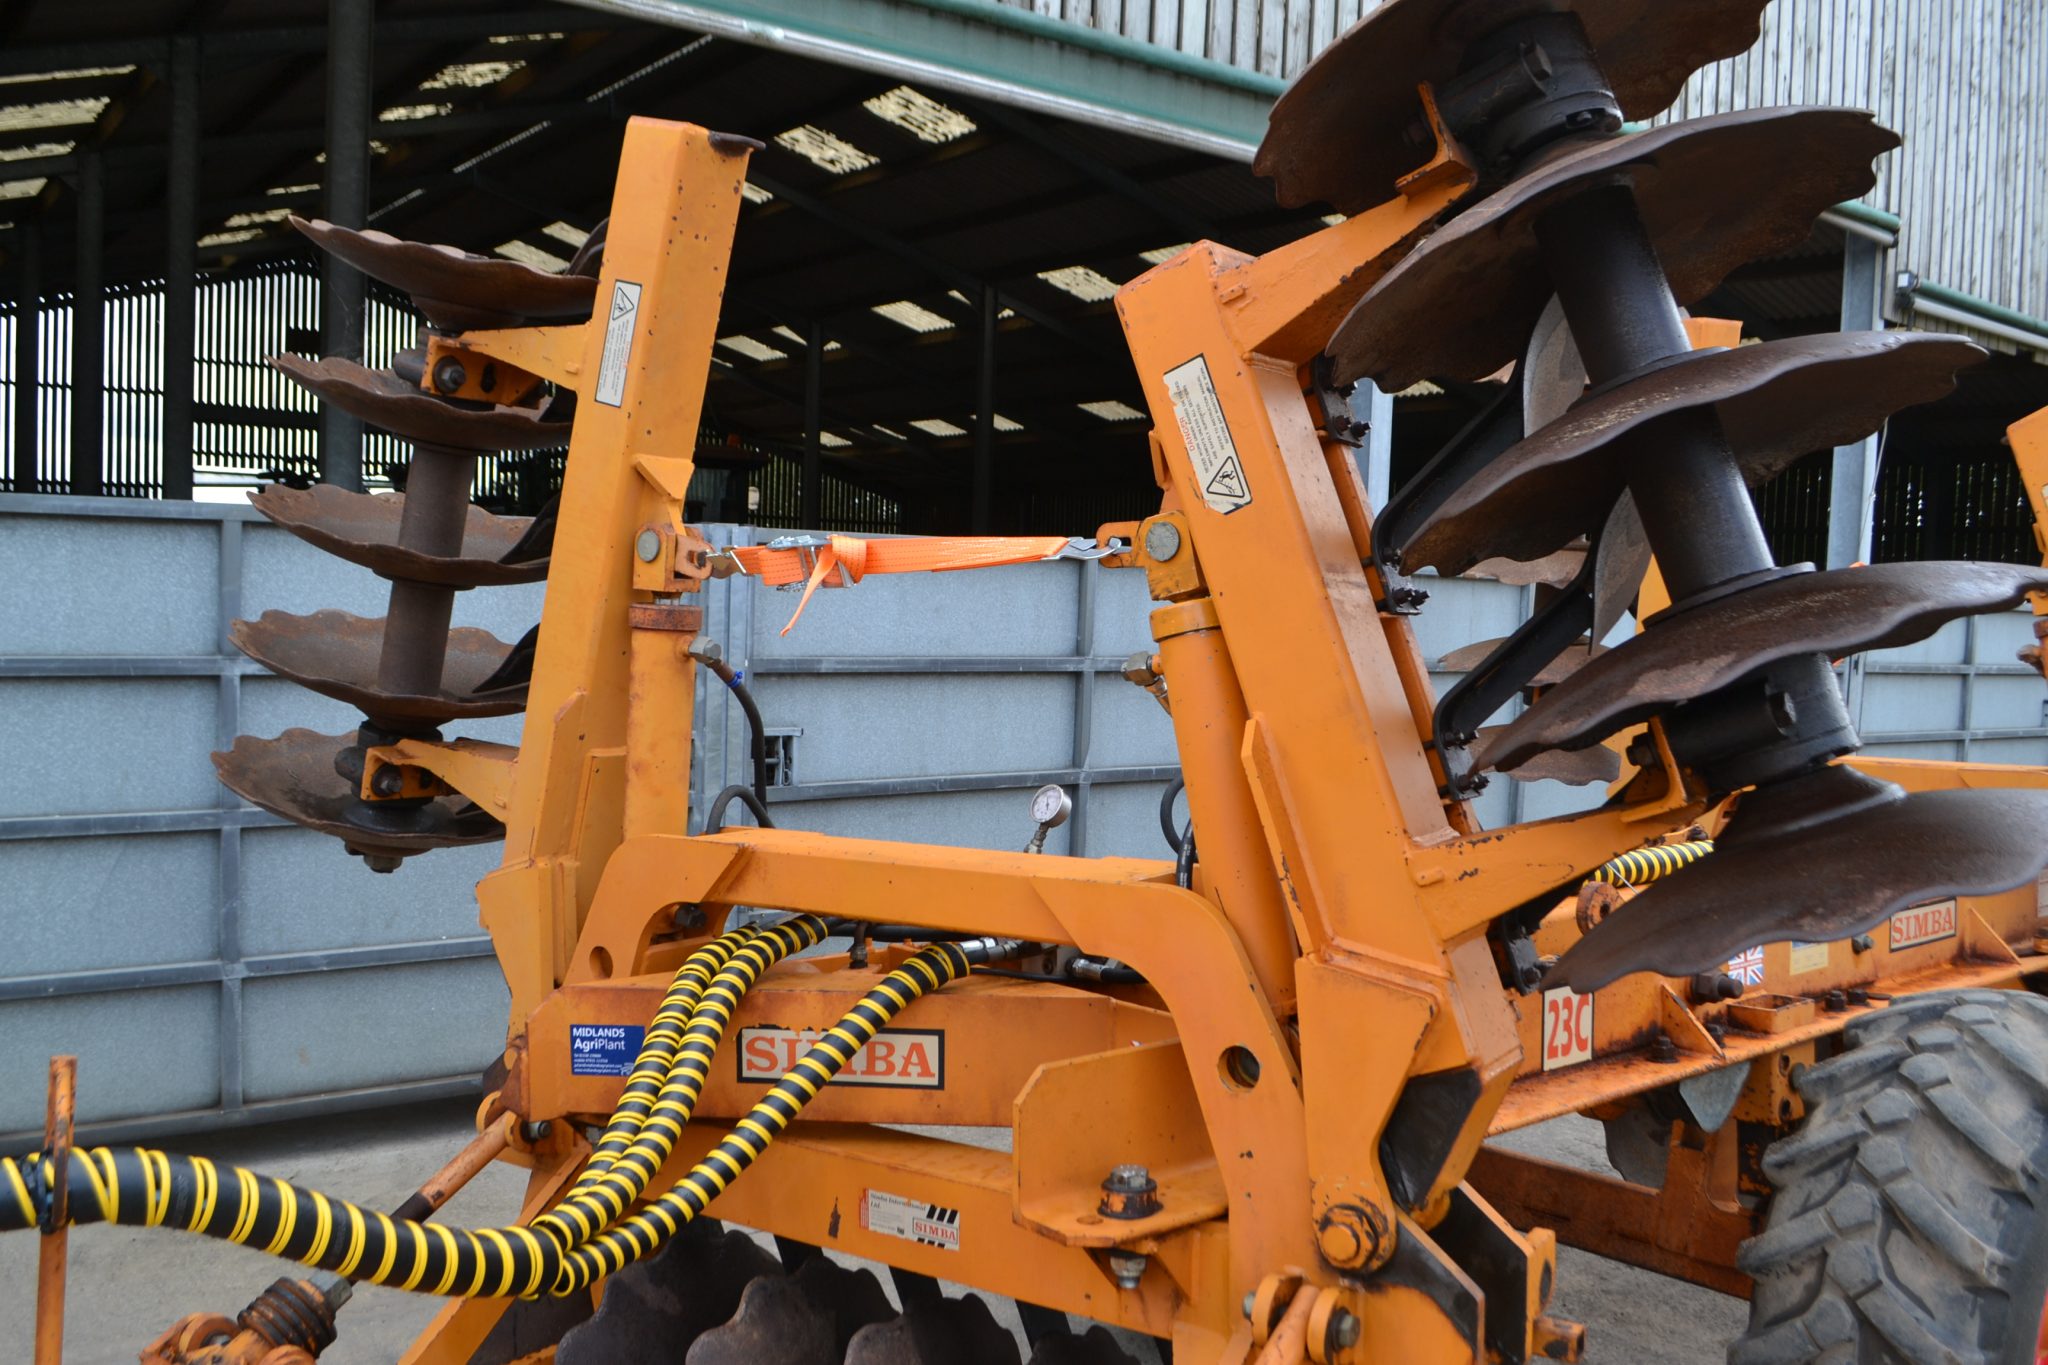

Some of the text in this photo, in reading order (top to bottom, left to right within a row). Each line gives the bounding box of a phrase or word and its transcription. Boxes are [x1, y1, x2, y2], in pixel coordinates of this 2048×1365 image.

[1178, 416, 1195, 451] DANGER
[1893, 907, 1953, 944] SIMBA
[573, 1027, 625, 1038] MIDLANDS
[1547, 993, 1590, 1060] 23C
[573, 1038, 626, 1052] AgriPlant
[914, 1221, 956, 1241] SIMBA
